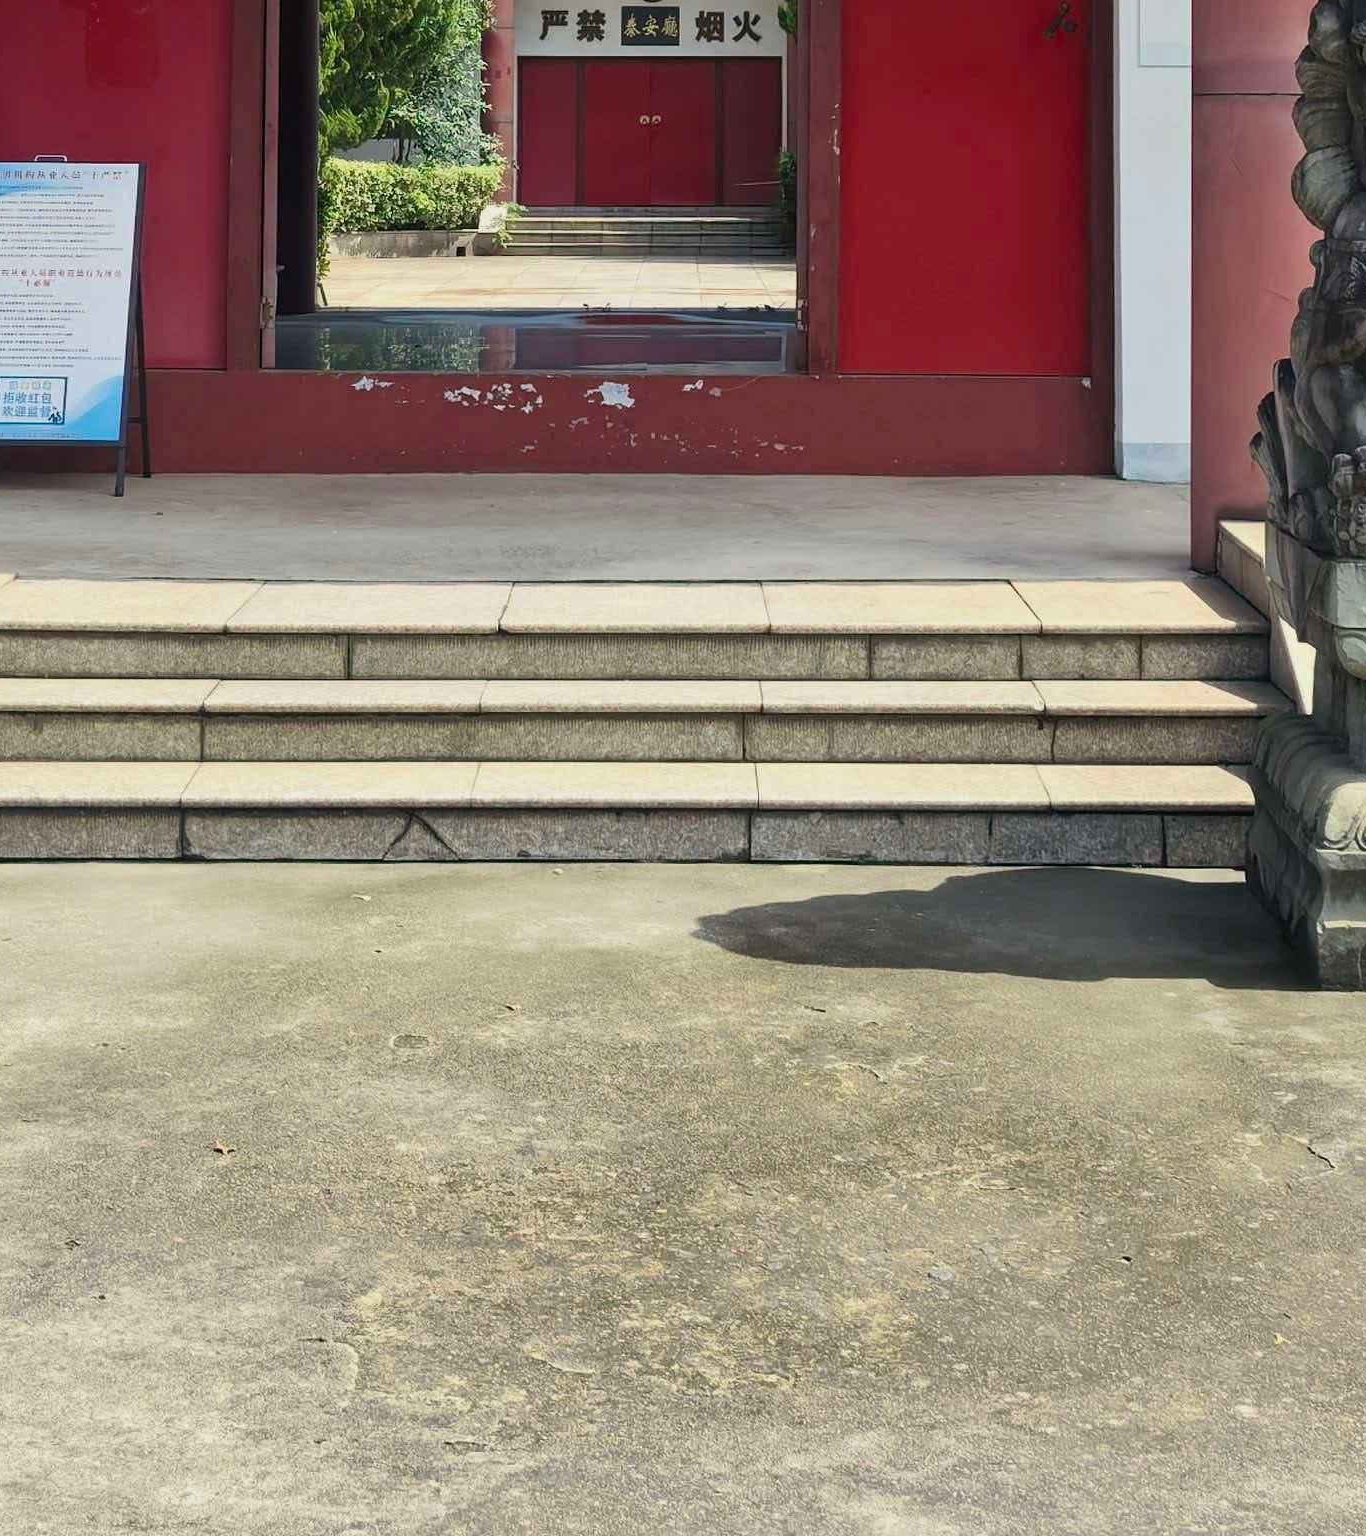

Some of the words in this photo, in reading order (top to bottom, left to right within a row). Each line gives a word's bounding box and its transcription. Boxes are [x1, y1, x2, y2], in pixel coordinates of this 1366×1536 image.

[539, 9, 606, 43] 严禁
[695, 10, 762, 43] 烟火
[2, 391, 52, 405] 拒收红包
